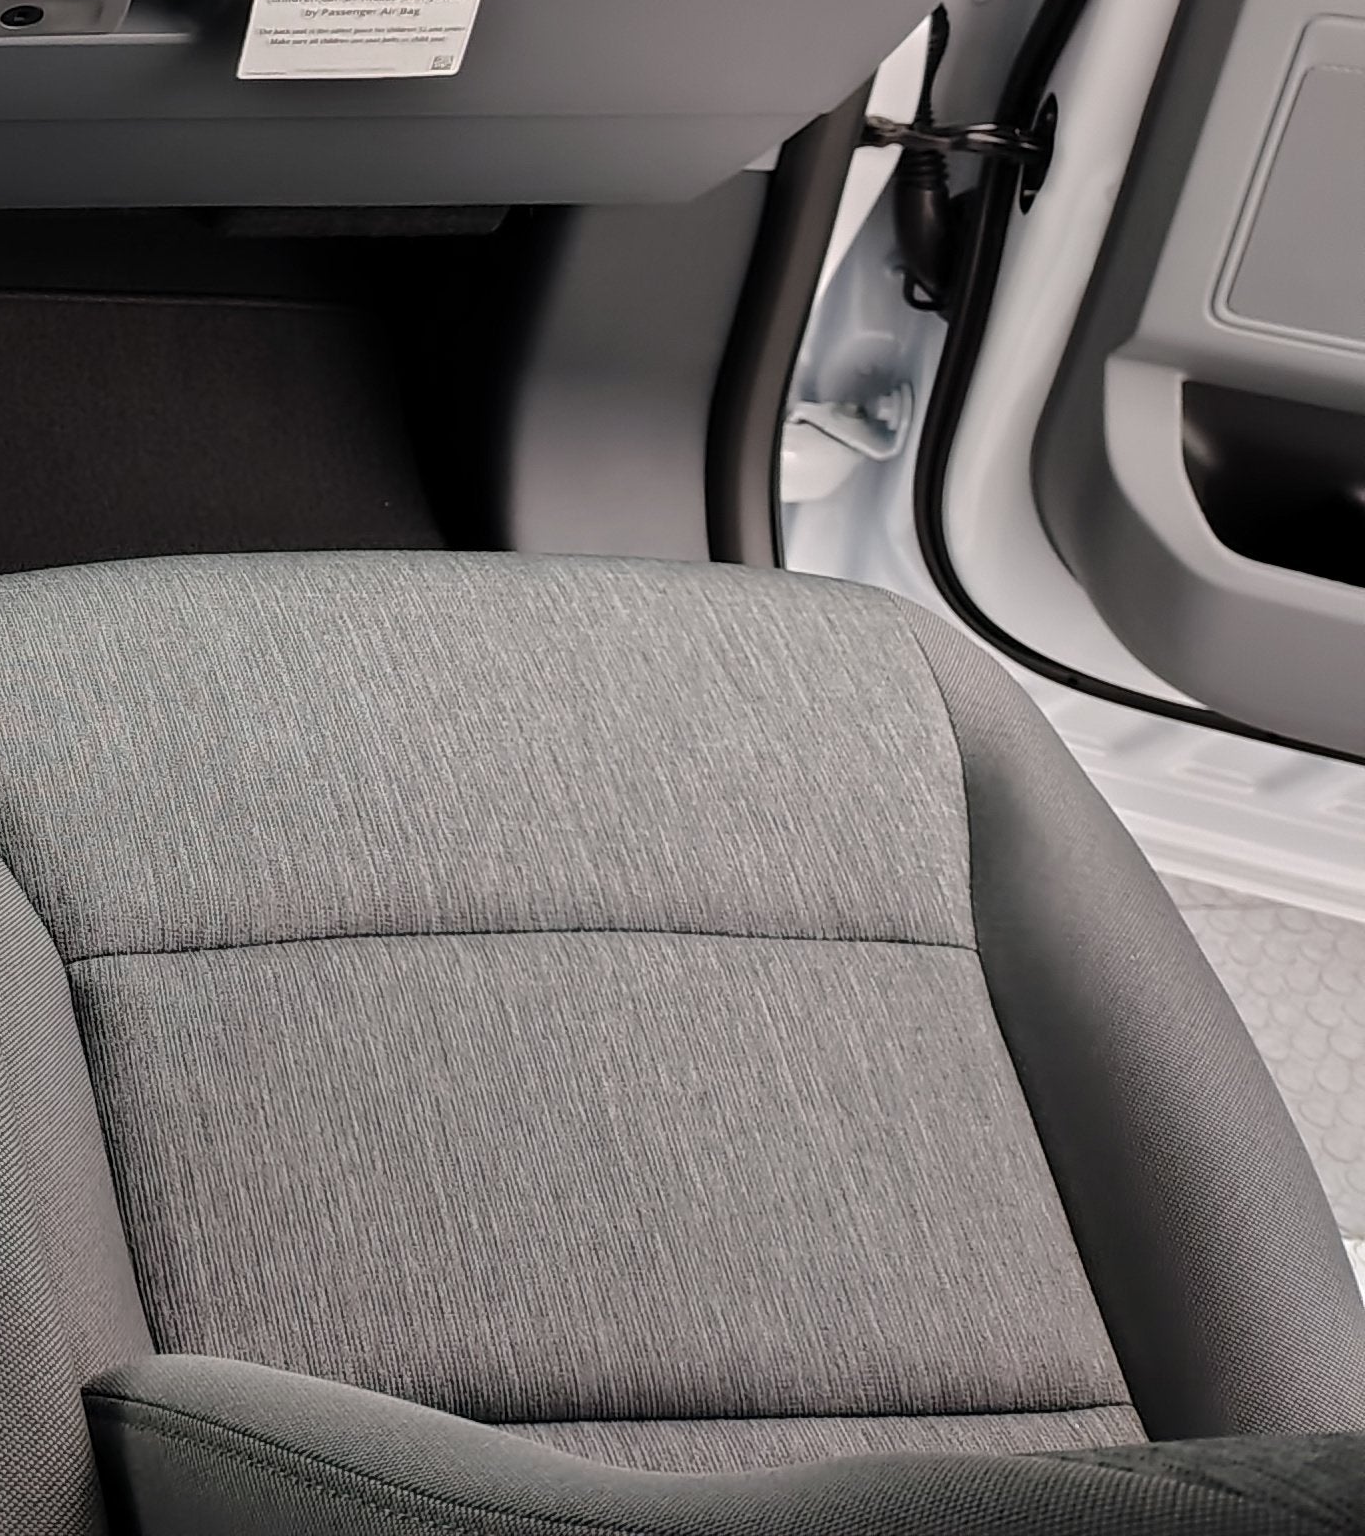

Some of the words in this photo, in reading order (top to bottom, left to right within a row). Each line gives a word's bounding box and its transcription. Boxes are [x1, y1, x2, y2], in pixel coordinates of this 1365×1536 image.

[305, 8, 318, 17] by
[321, 8, 376, 17] Passenger
[400, 8, 421, 16] Bag
